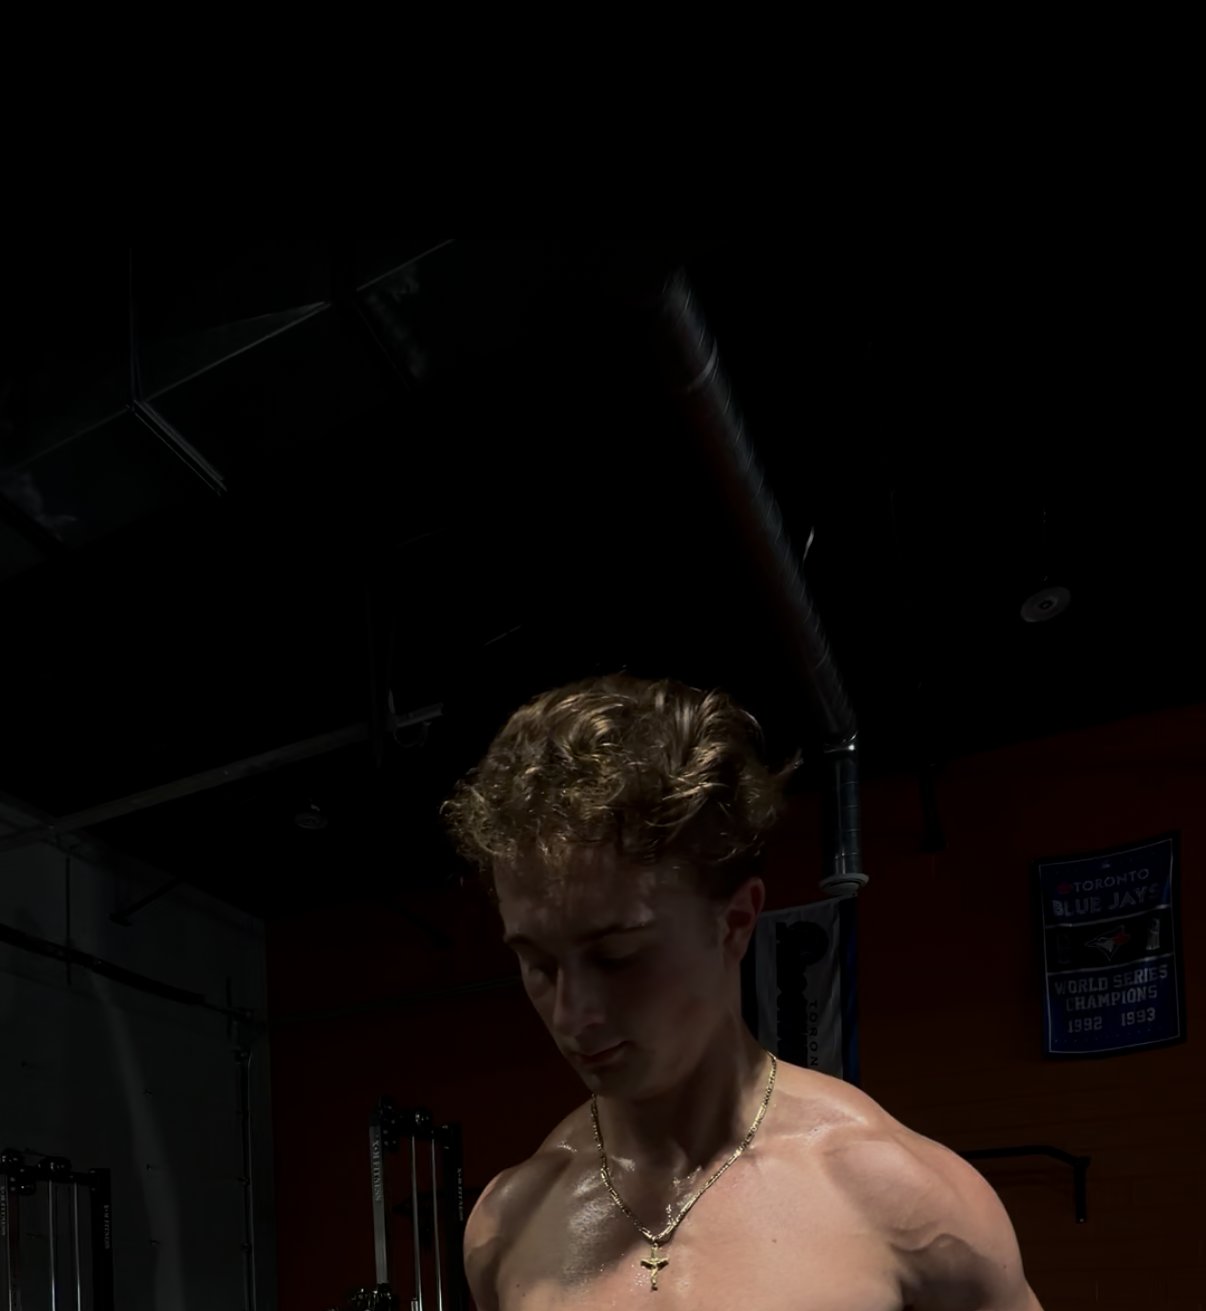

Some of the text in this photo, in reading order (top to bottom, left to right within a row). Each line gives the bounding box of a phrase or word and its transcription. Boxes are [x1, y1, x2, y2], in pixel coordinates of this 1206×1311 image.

[1073, 868, 1150, 893] TORONTO
[1052, 882, 1160, 917] BLUE JAYS
[1054, 964, 1168, 995] WORLD SERIES
[1066, 985, 1158, 1012] CHAMPIONS
[1067, 1007, 1156, 1034] 1992 1993
